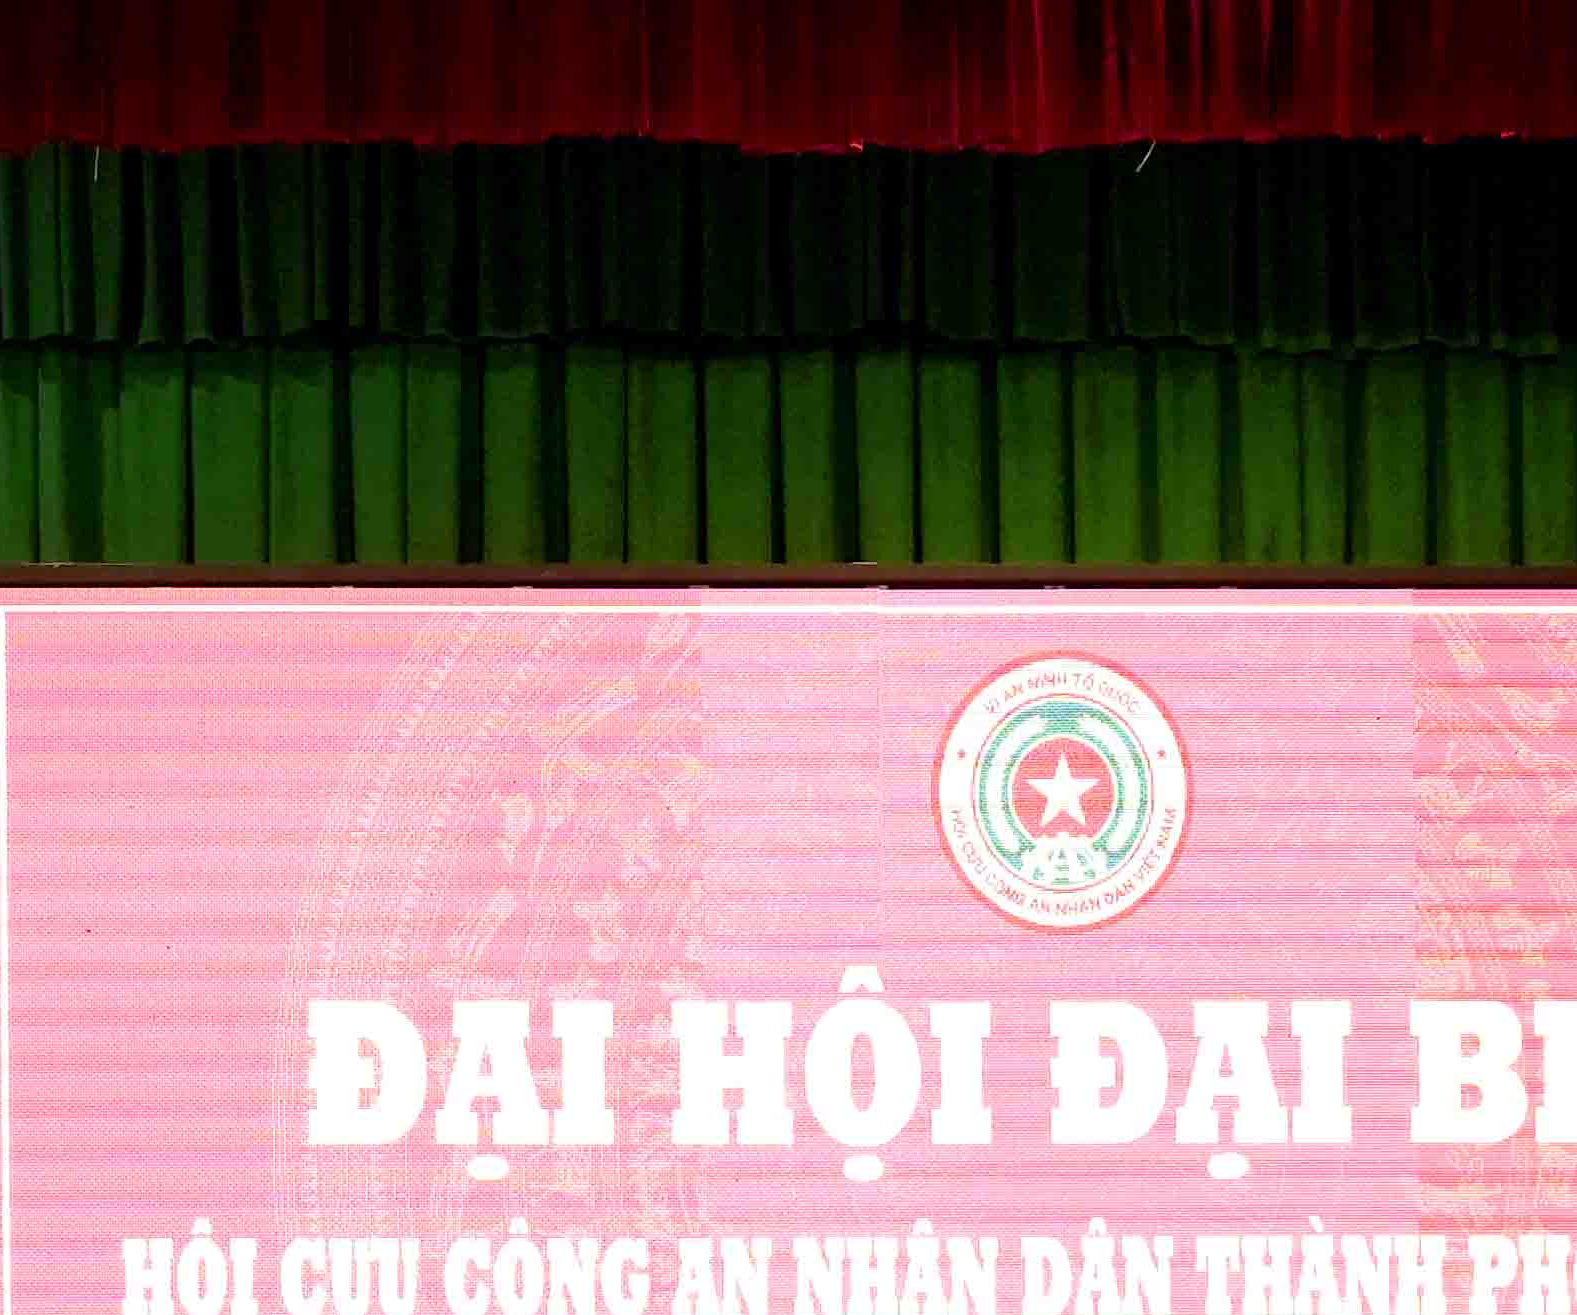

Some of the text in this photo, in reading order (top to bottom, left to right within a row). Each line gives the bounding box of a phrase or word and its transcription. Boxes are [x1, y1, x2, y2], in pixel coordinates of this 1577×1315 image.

[307, 999, 614, 1181] ĐẠI
[670, 965, 992, 1181] HỘI
[1048, 1000, 1354, 1181] ĐẠI
